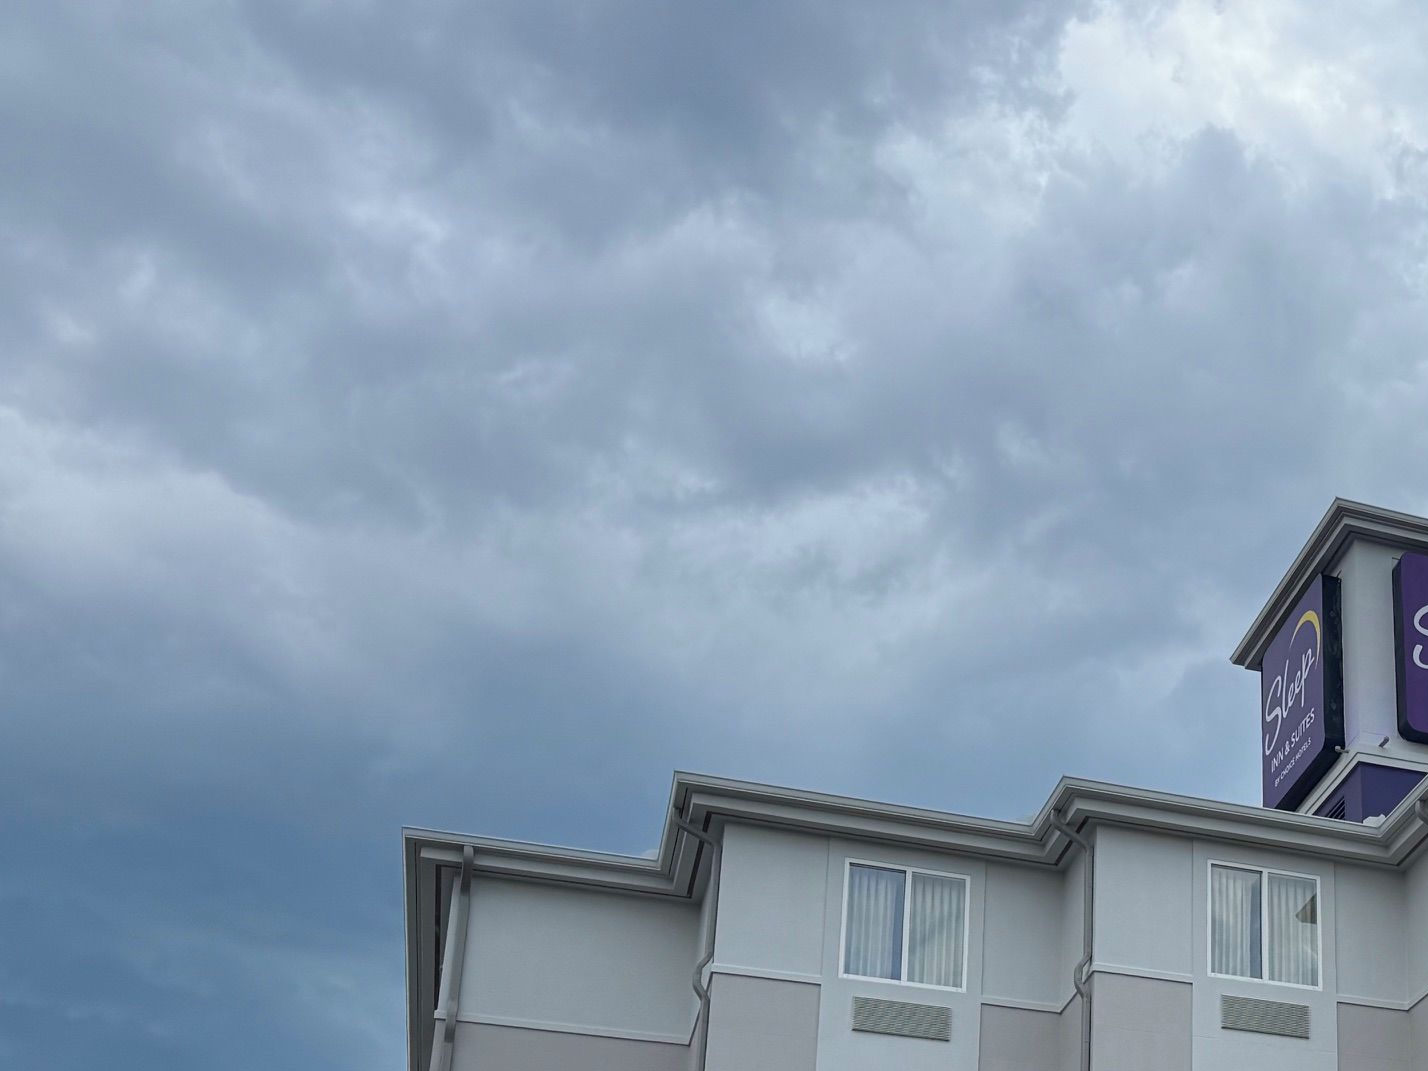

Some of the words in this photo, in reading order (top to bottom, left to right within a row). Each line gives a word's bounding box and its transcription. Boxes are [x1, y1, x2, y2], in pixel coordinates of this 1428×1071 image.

[1265, 648, 1316, 756] Sleep
[1271, 747, 1284, 773] INN
[1285, 740, 1290, 755] &
[1291, 707, 1315, 748] SUITES
